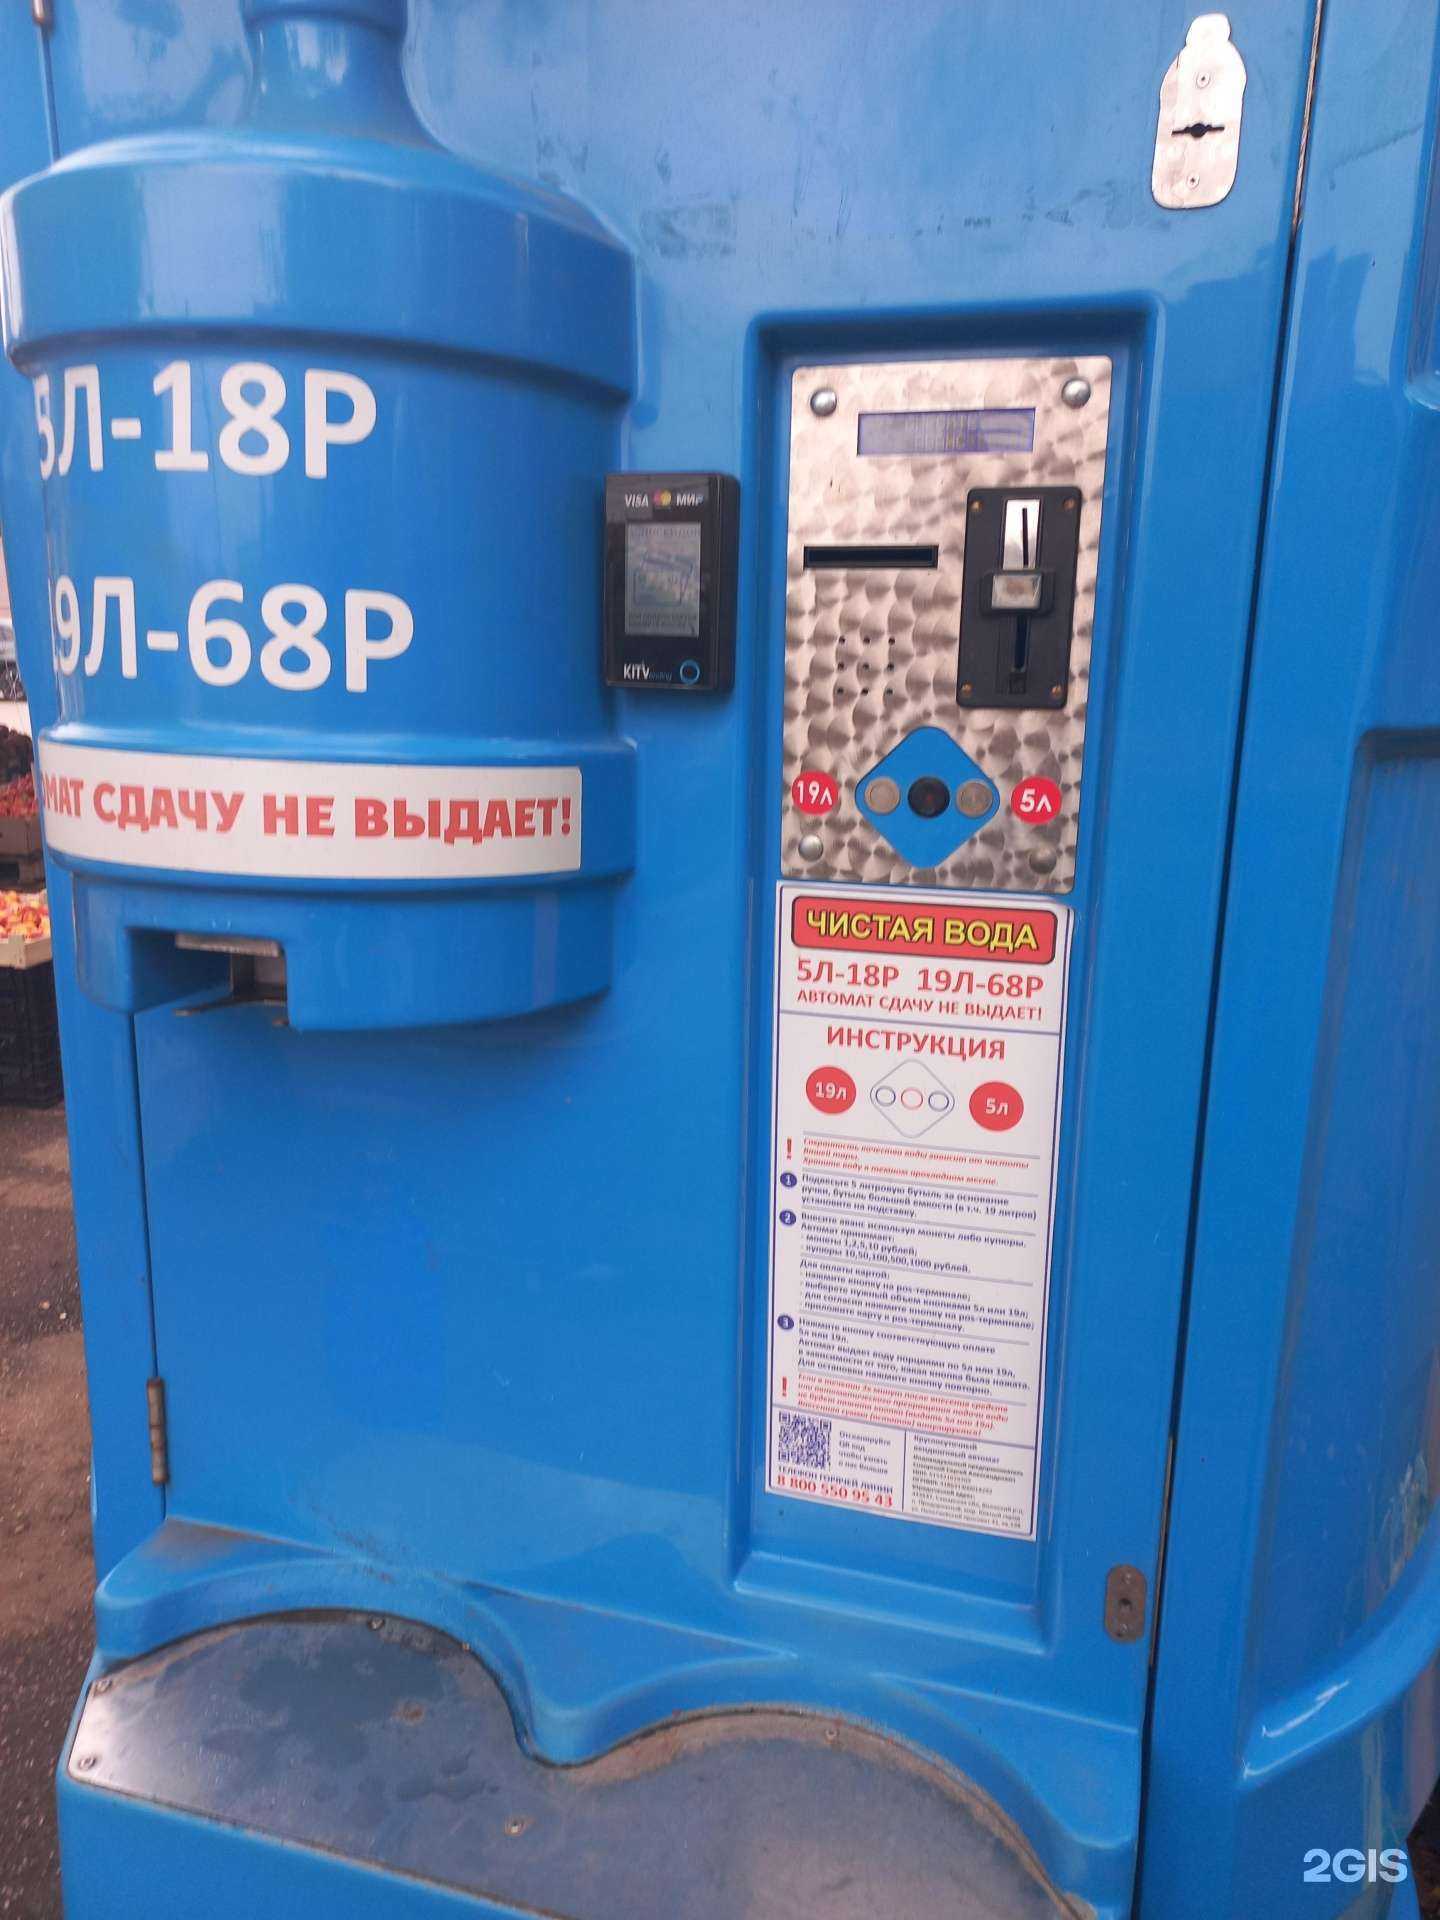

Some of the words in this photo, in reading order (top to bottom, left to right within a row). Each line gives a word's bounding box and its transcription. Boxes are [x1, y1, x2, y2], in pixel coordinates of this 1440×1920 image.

[625, 493, 649, 508] VISA
[48, 575, 414, 693] 9Л-68Р
[93, 783, 245, 832] СДАЧУ
[263, 795, 335, 838] НЕ
[354, 796, 573, 846] ВЫДАЕТ!
[806, 908, 935, 943] ЧИСТАЯ
[944, 918, 1039, 952] ВОДА
[797, 957, 900, 989] 5Л-18Р
[917, 968, 1044, 999] 19Л-68Р
[797, 990, 874, 1009] АВТОМАТ
[879, 997, 932, 1013] СДАЧУ
[938, 1002, 959, 1015] НЕ
[965, 1005, 1042, 1021] ВЫДАЕТ!
[827, 1026, 1005, 1061] ИНСТРУКЦИЯ
[815, 1081, 847, 1100] 19л
[985, 1098, 1009, 1115] 5л
[785, 1175, 791, 1185] 1
[784, 1212, 790, 1223] 2
[790, 1477, 816, 1492] 800
[821, 1483, 847, 1498] 550
[852, 1489, 869, 1502] 95
[875, 1493, 892, 1507] 43
